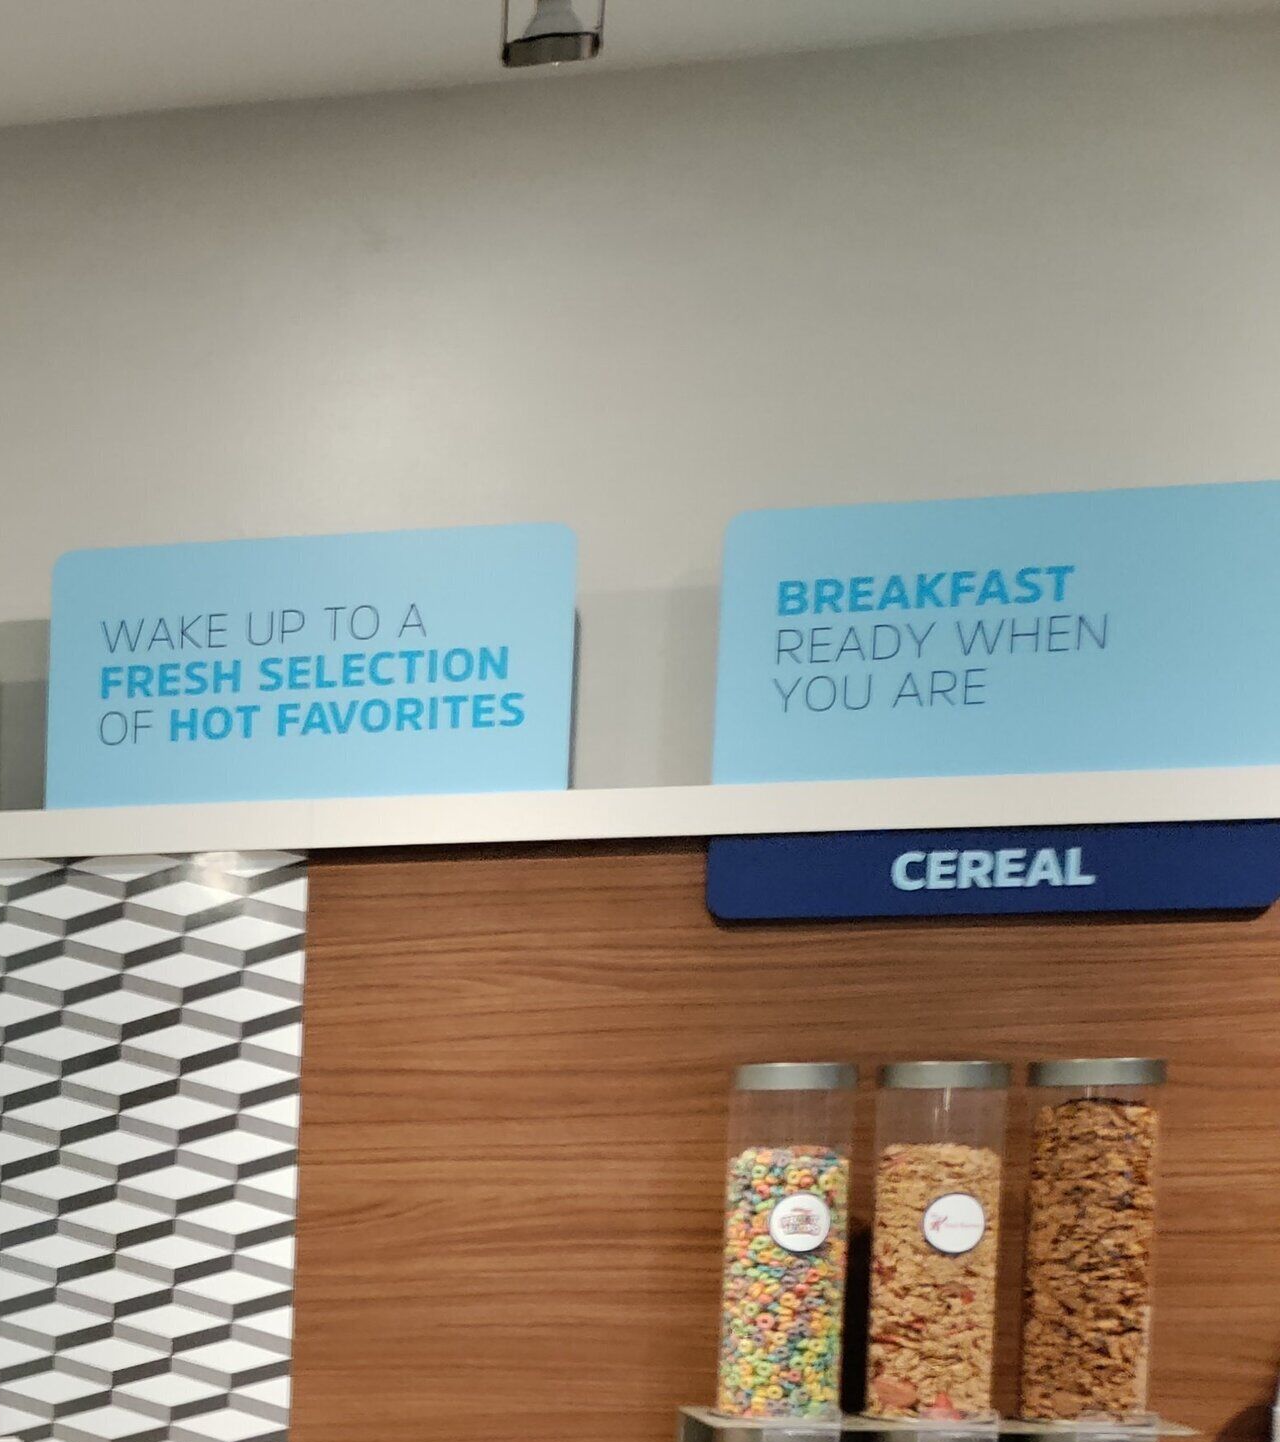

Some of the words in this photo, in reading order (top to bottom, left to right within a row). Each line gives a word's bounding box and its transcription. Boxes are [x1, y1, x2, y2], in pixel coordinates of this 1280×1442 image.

[777, 565, 1076, 617] BREAKFAST
[100, 612, 229, 654] WAKE
[245, 608, 306, 647] UP
[324, 604, 381, 642] TO
[397, 602, 428, 639] A
[774, 621, 938, 666] READY
[955, 613, 1111, 657] WHEN
[100, 659, 242, 700] FRESH
[258, 646, 510, 692] SELECTION
[773, 673, 873, 714] YOU
[892, 667, 989, 710] ARE
[97, 709, 155, 747] OF
[169, 704, 261, 743] HOT
[277, 691, 527, 738] FAVORITES
[889, 846, 1097, 892] CEREAL
